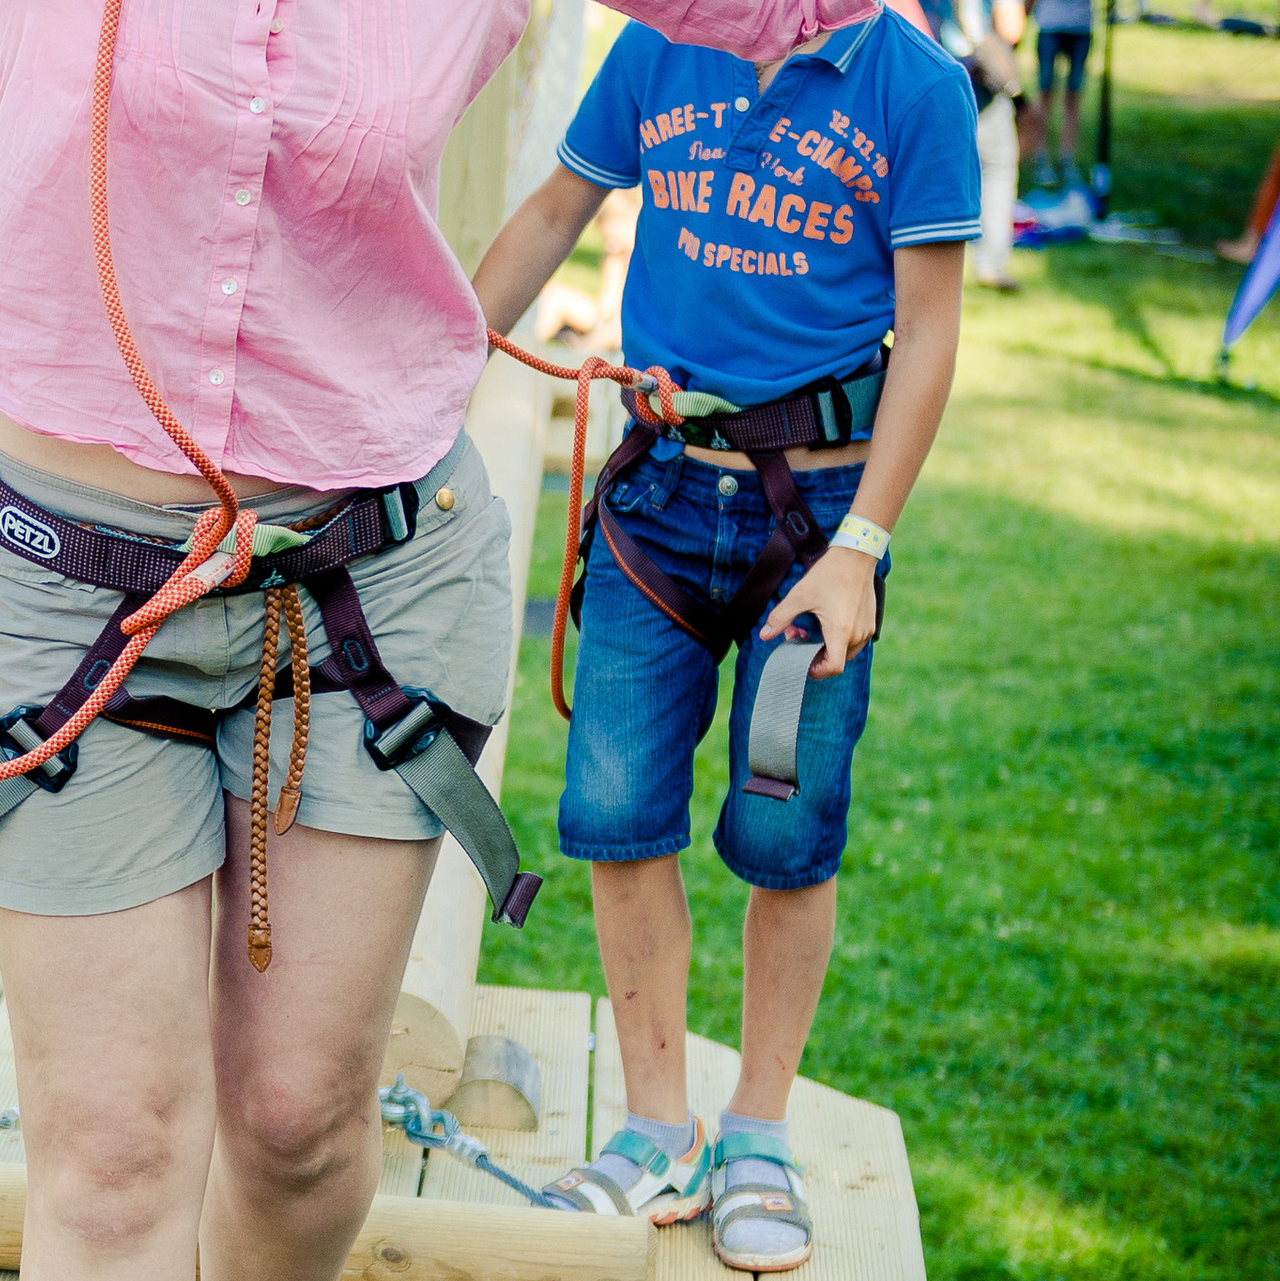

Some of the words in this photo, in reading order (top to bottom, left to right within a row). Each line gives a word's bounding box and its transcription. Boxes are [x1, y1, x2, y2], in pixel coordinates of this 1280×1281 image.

[647, 169, 714, 214] BIKE
[725, 172, 854, 245] RACES
[703, 242, 809, 276] SPECIALS
[4, 512, 53, 554] PETZL
